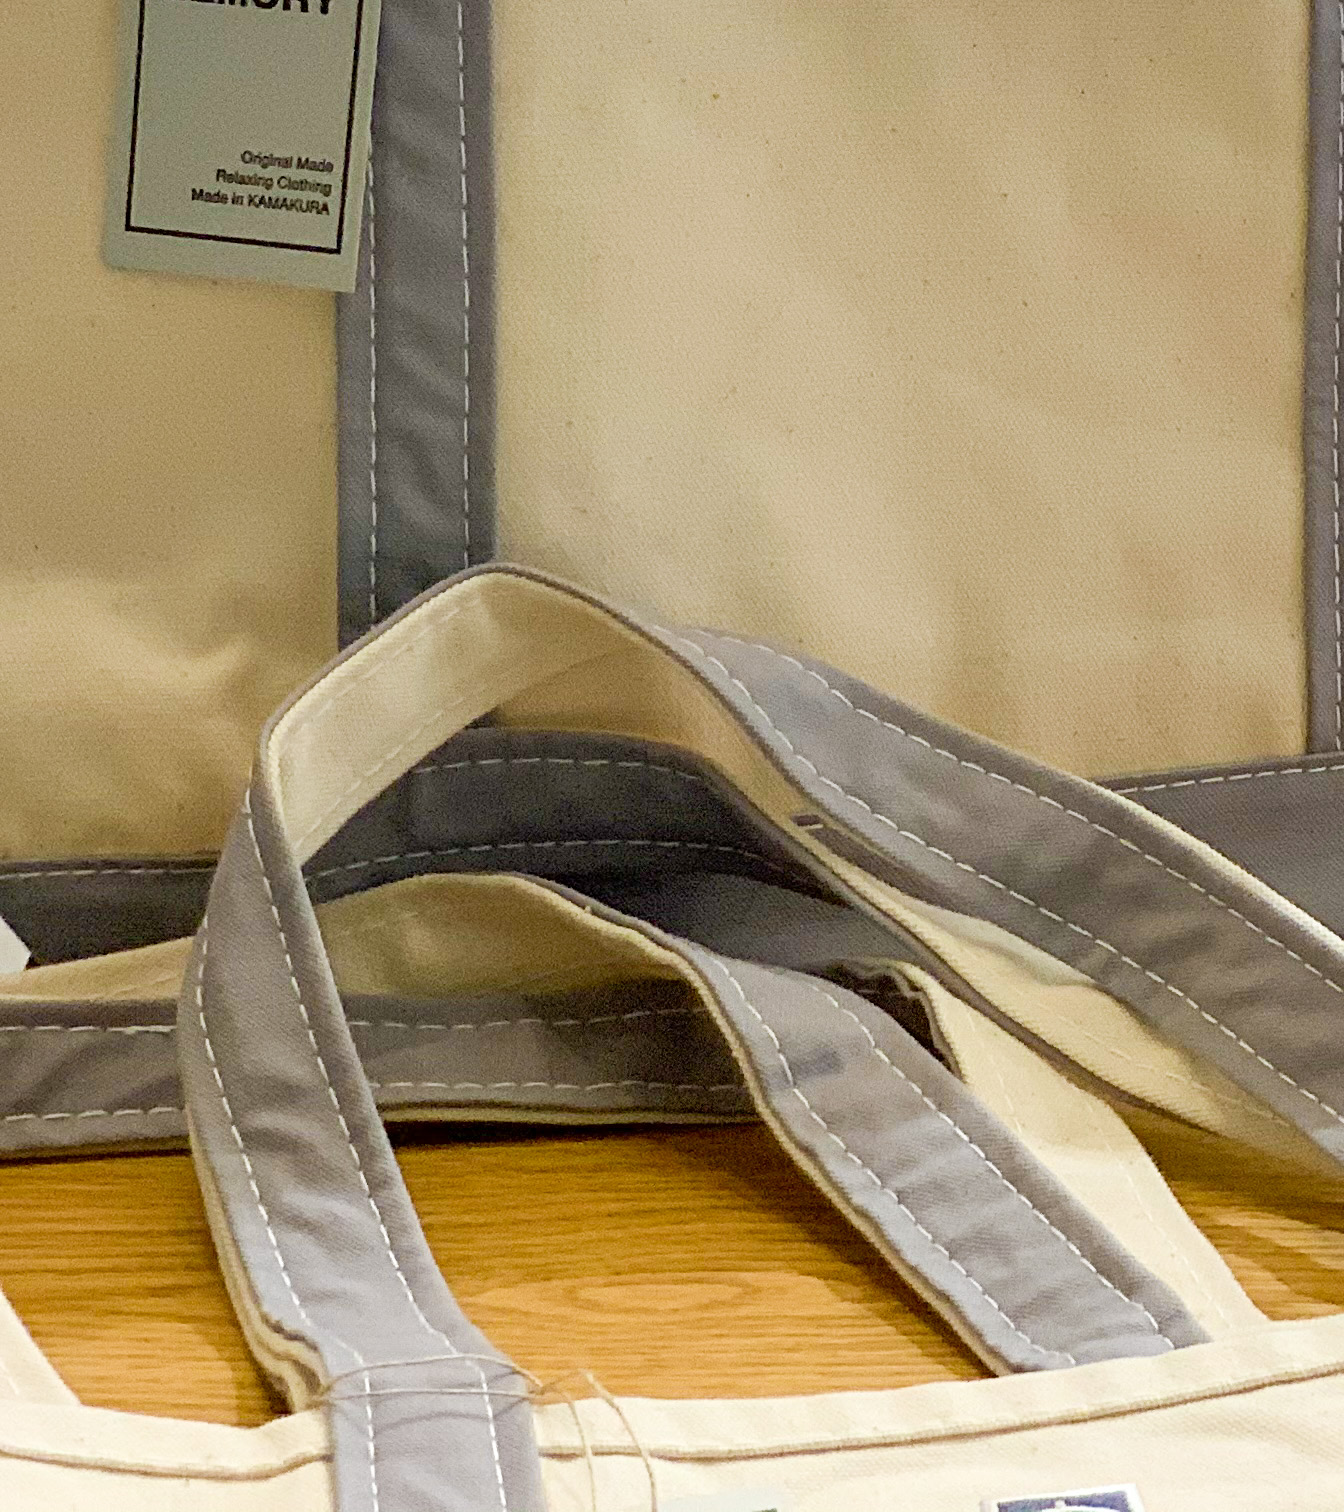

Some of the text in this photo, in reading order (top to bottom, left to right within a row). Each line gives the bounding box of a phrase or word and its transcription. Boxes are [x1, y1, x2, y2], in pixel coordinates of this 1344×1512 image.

[240, 150, 334, 173] Original Made
[216, 168, 332, 197] Relaxing Clothing
[191, 188, 330, 216] Made in KAMAKURA
